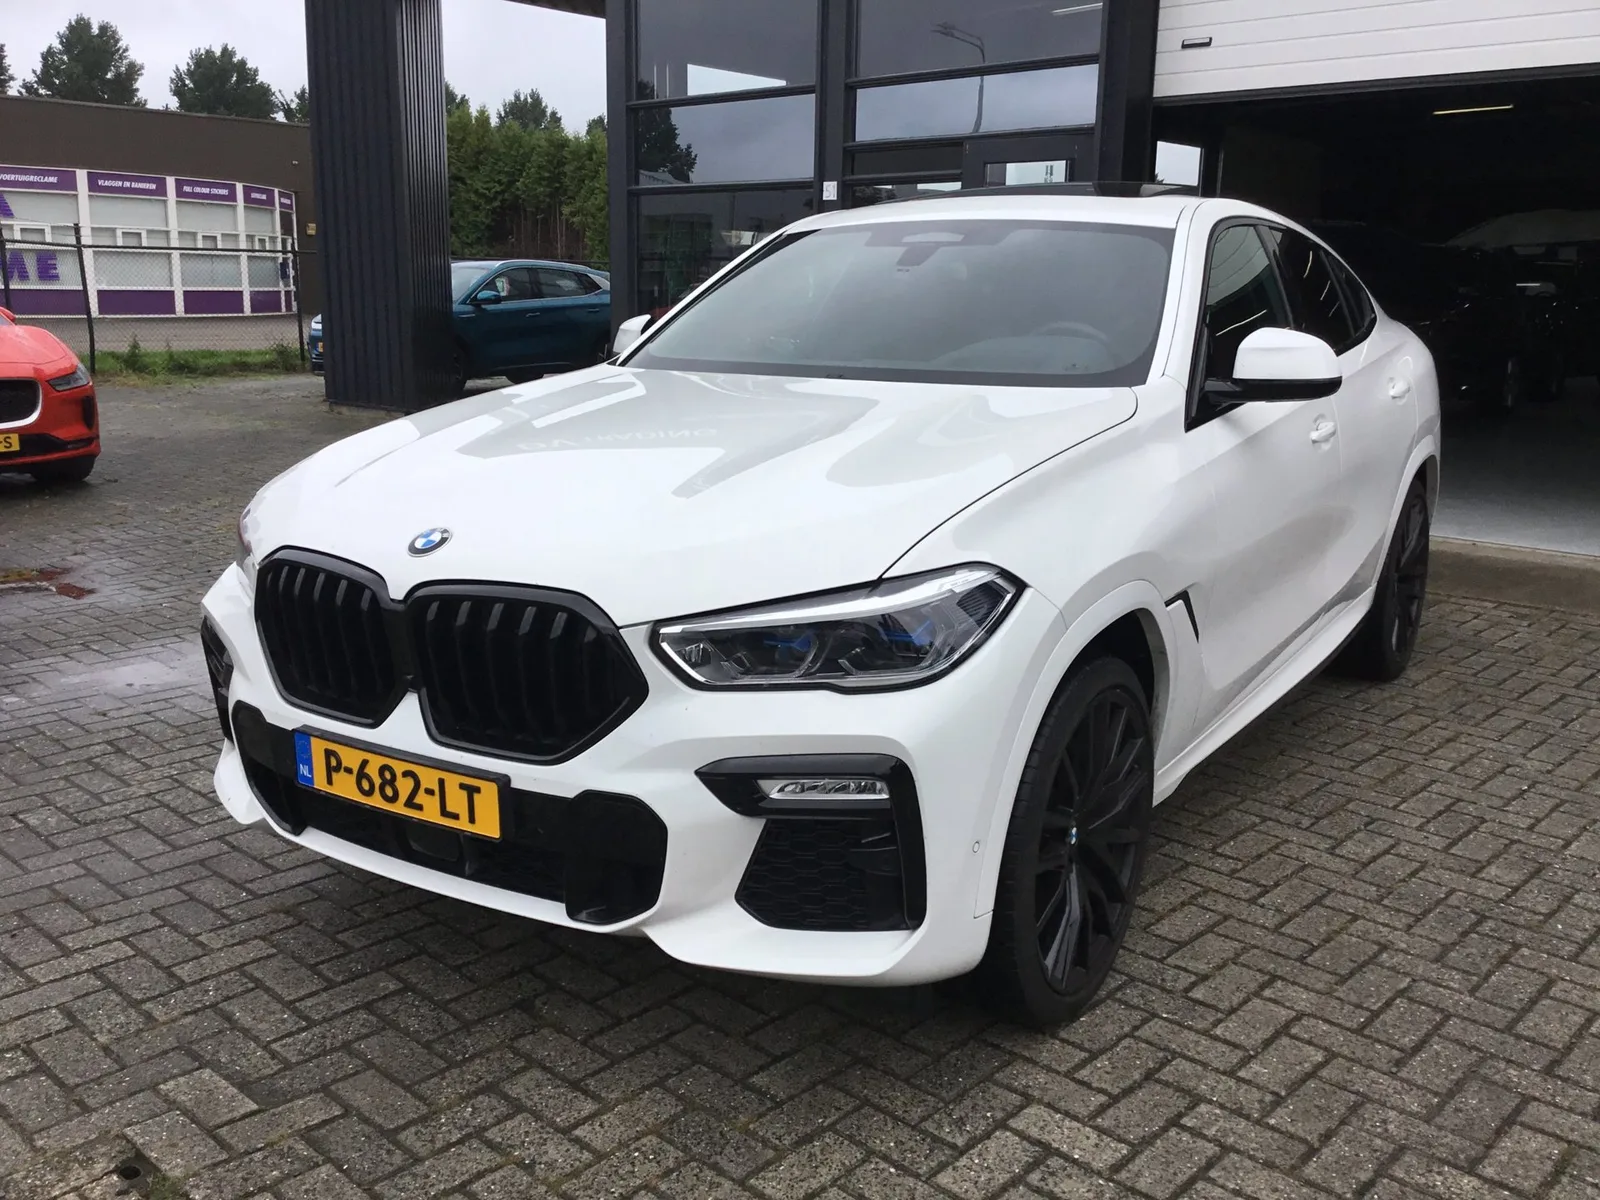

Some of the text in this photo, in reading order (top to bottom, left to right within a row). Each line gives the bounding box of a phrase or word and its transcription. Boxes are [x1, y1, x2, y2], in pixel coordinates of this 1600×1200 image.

[0, 173, 58, 183] VOERTUIGRECLAME
[98, 179, 122, 187] VLAGGEN
[131, 181, 157, 190] BANIEREN
[299, 763, 312, 778] NL
[323, 747, 482, 825] P-682-LT
